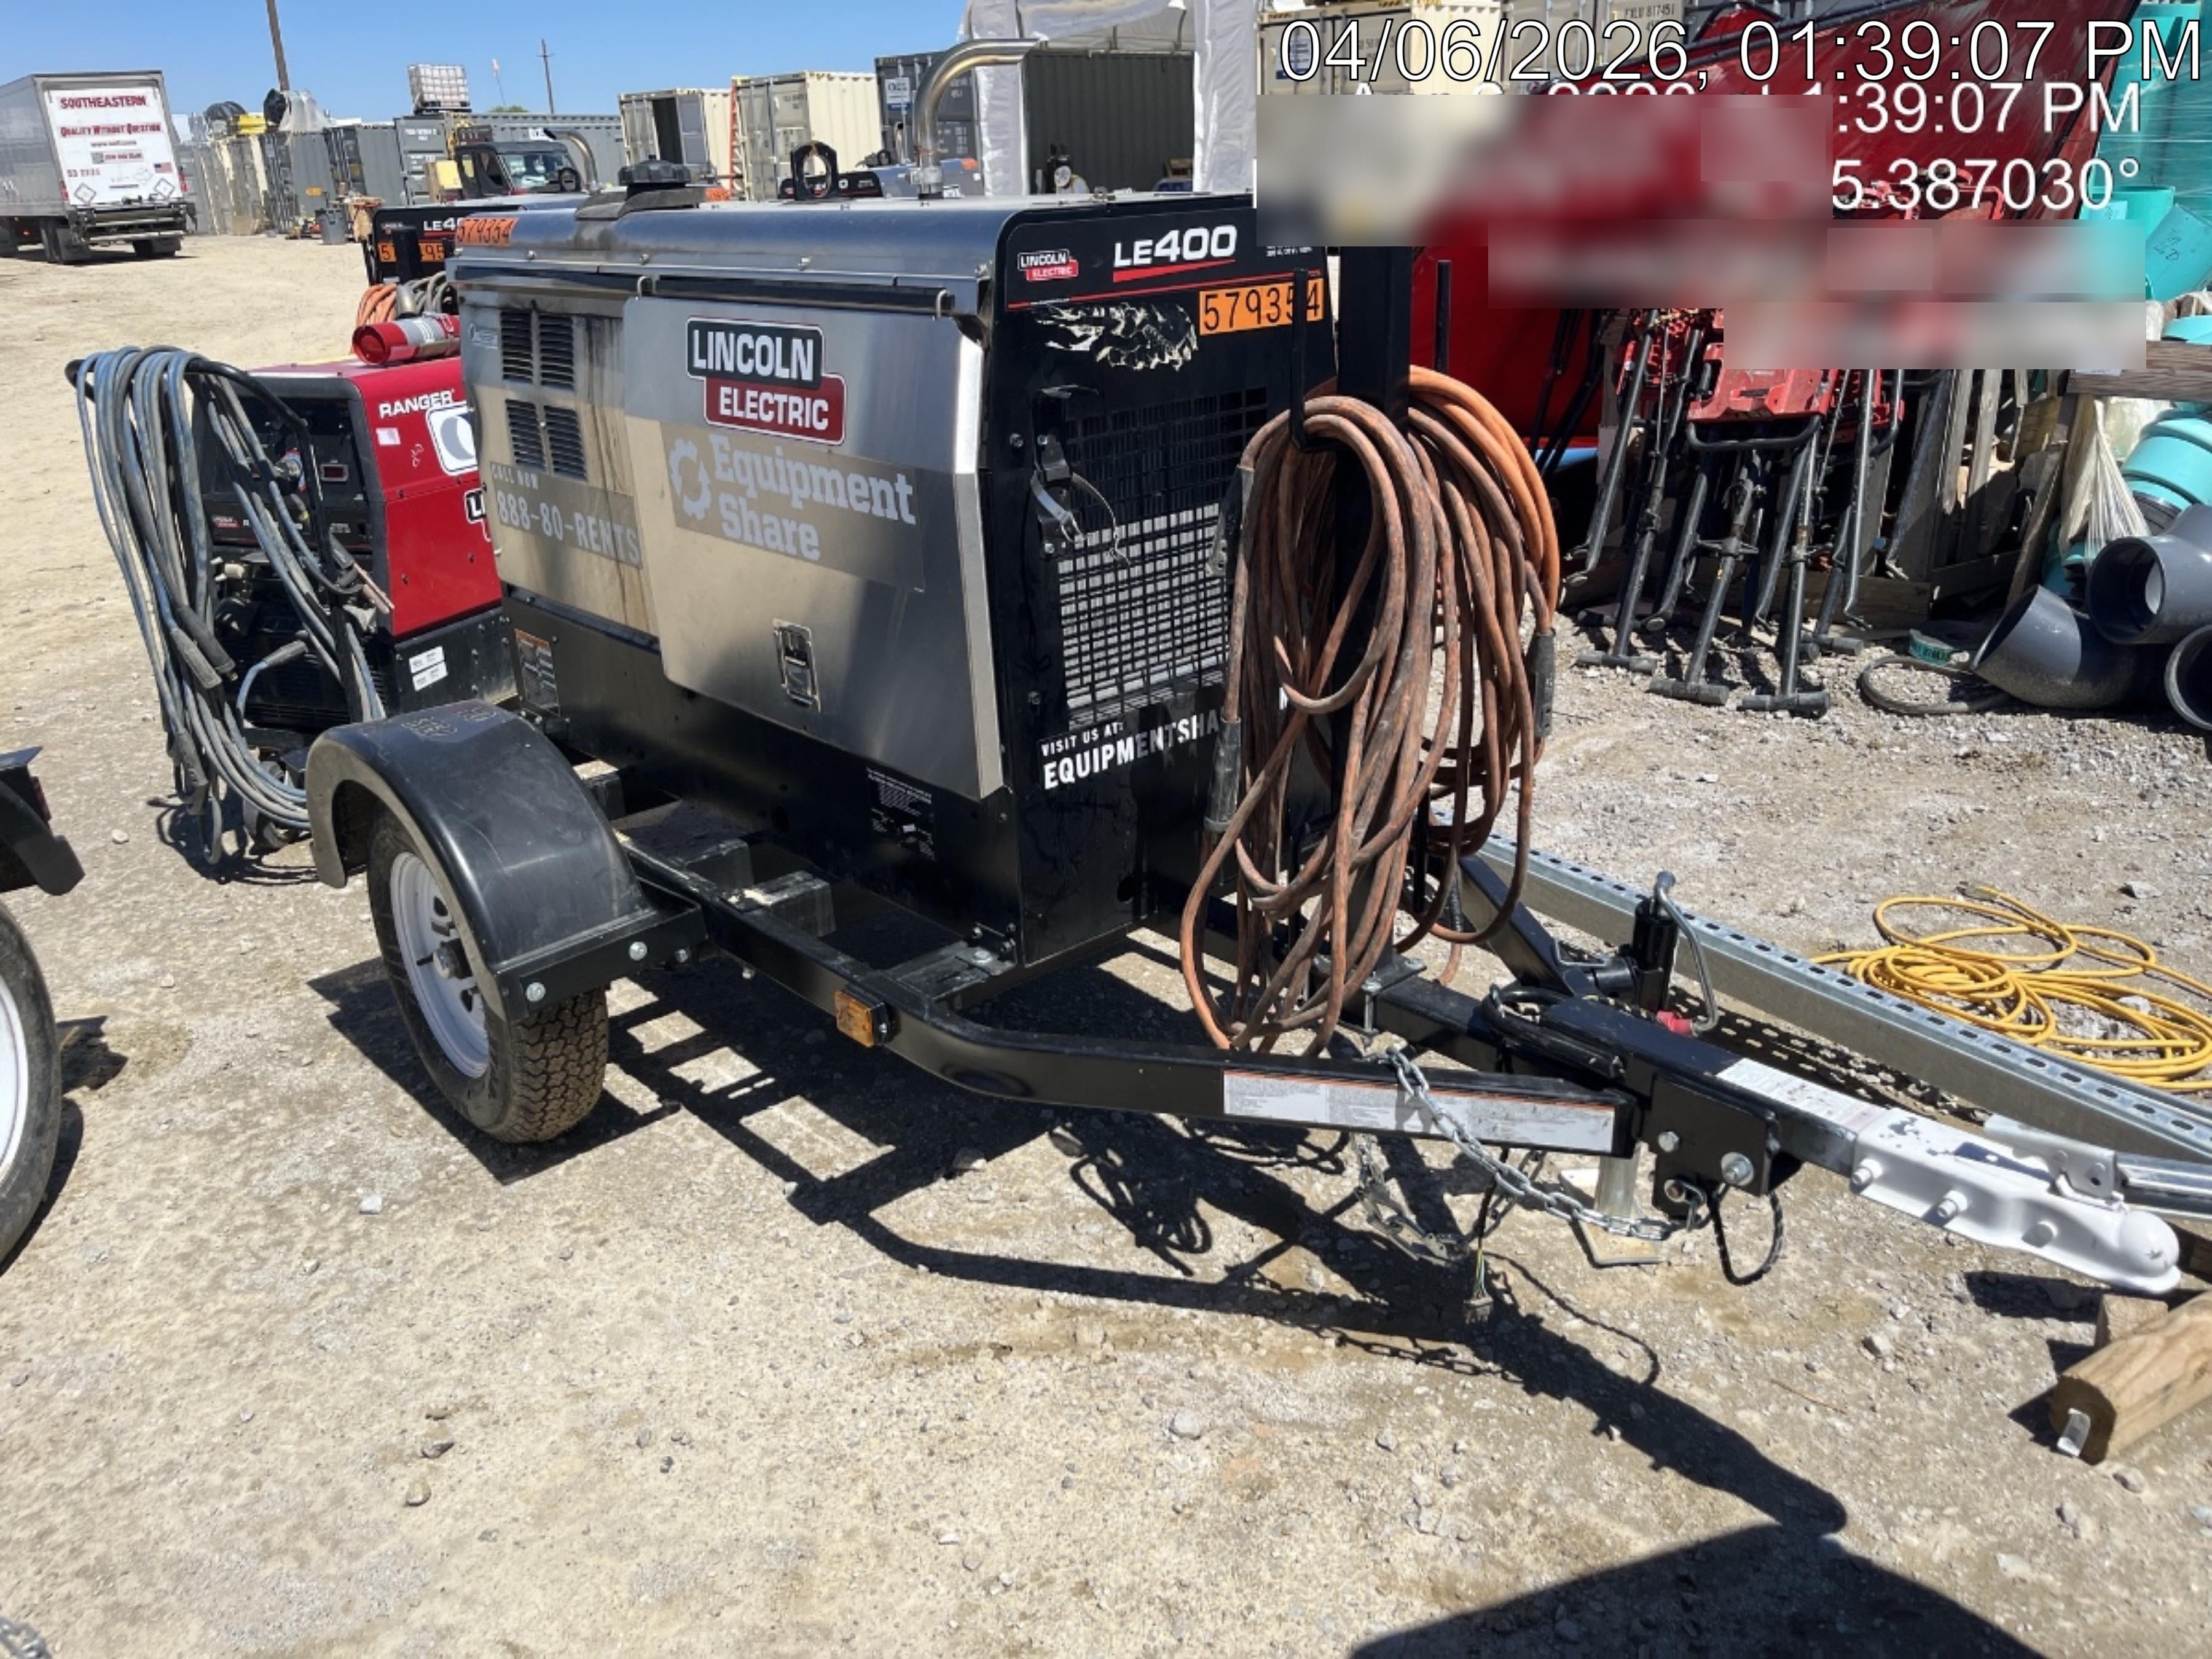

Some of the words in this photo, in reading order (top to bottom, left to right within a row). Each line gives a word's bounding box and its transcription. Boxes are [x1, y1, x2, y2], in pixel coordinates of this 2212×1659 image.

[60, 95, 146, 109] SOUTHEASTERN
[423, 217, 459, 232] LE4
[1021, 252, 1067, 268] LINCOLN
[1113, 225, 1236, 267] LE400
[1032, 266, 1073, 277] ELECTRIC
[692, 329, 814, 382] LINCOLN
[378, 390, 453, 420] RANGER
[719, 386, 829, 430] ELECTRIC
[492, 464, 514, 484] CALL
[709, 434, 917, 525] Equipment
[496, 490, 641, 565] 888-80-RENTS
[718, 493, 821, 561] Share
[1041, 735, 1077, 757] VISIT
[1083, 728, 1099, 743] US
[1104, 722, 1124, 737] AT:
[1044, 709, 1220, 790] EQUIPMENTSHA
